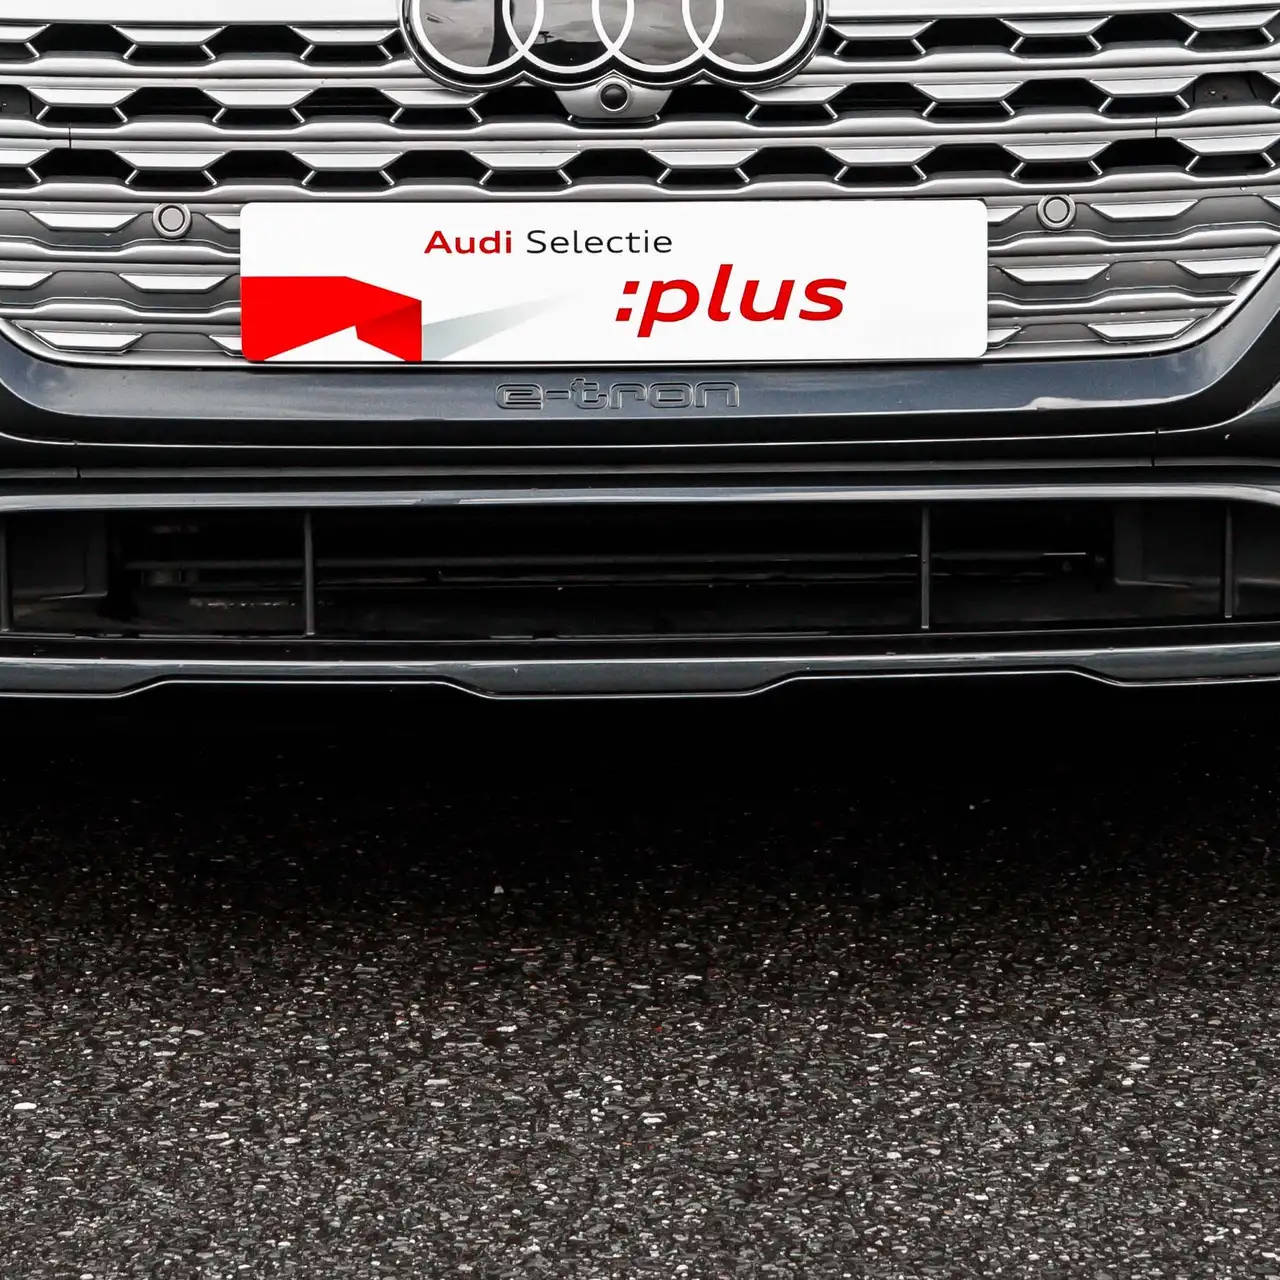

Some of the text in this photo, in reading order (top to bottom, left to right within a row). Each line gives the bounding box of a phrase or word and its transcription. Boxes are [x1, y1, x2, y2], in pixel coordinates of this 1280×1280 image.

[424, 230, 672, 254] Audi Selectie
[615, 263, 847, 337] :plus
[494, 377, 740, 410] e-tron
